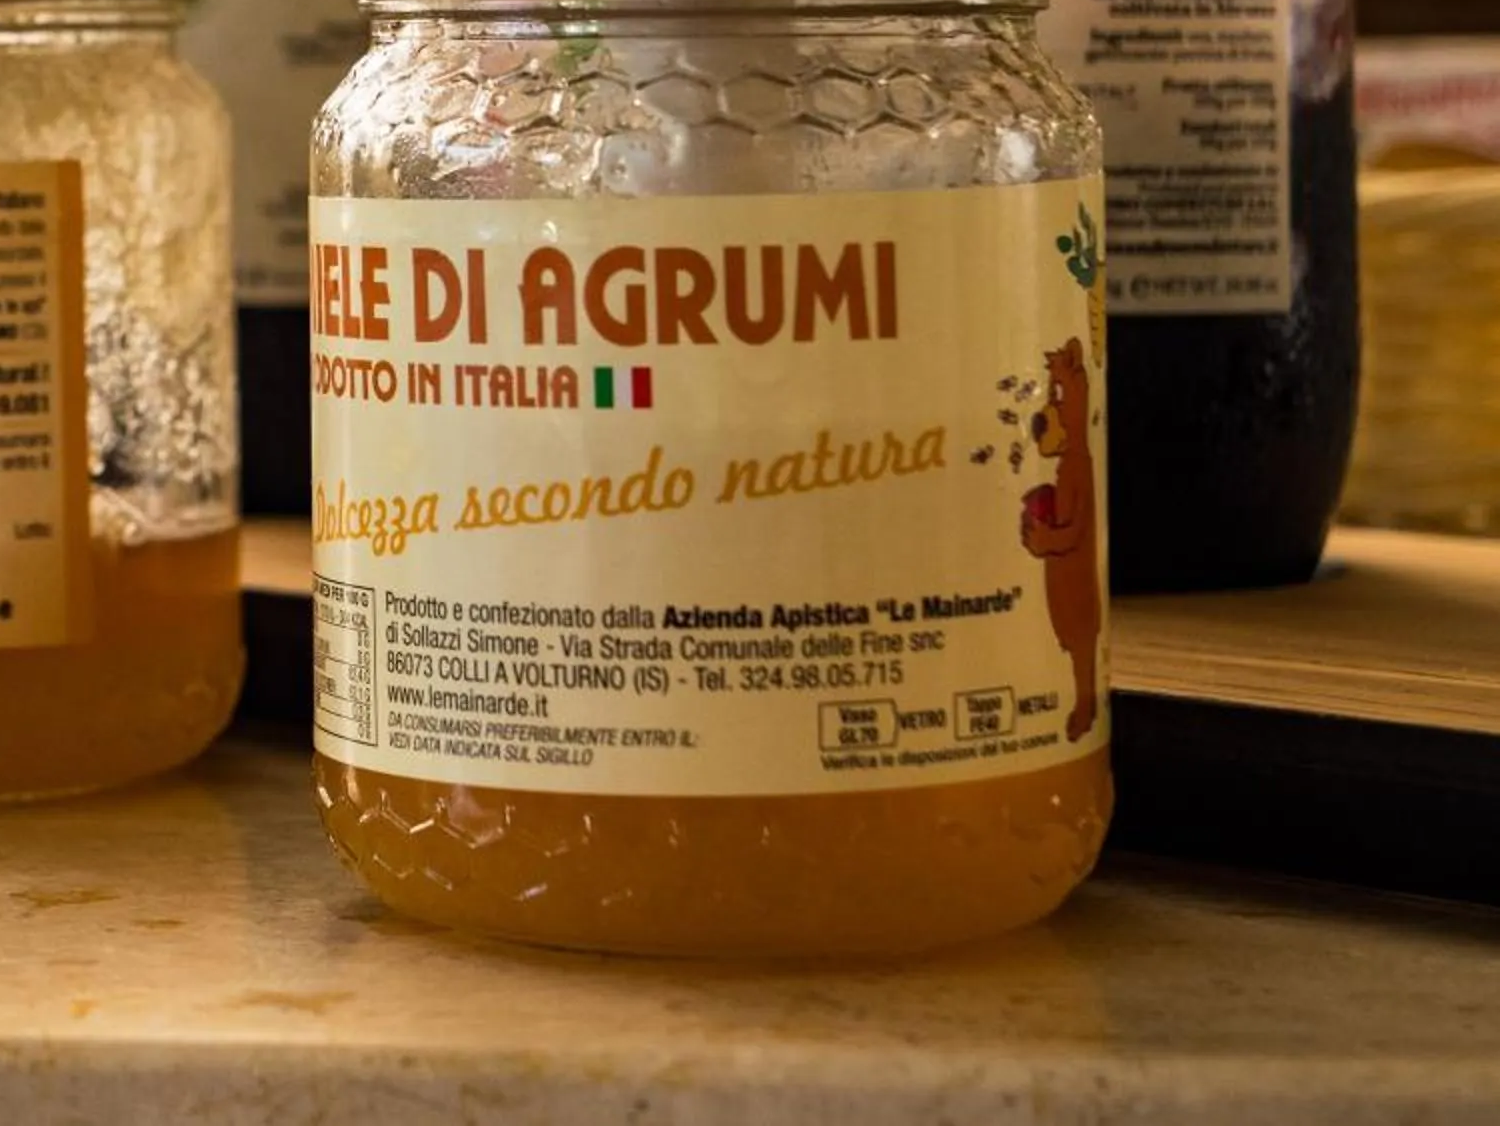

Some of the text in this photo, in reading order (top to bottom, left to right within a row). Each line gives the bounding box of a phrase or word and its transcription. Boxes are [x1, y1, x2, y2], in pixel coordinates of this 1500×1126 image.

[313, 240, 898, 347] IELE DI AGRUMI
[407, 361, 442, 405] IN
[454, 364, 579, 410] ITALIA
[315, 424, 949, 558] Dolcezza secondo natura
[385, 590, 448, 620] Prodotto
[452, 601, 464, 621] e
[468, 601, 596, 630] confezionato
[601, 603, 656, 630] dalla
[662, 603, 763, 630] Azienda
[770, 602, 871, 634] Apistica
[386, 622, 399, 645] di
[403, 624, 462, 652] Sollazzi
[467, 629, 540, 657] Simone
[560, 633, 593, 659] Via
[599, 634, 673, 662] Strada
[679, 634, 795, 662] Comunale
[801, 631, 854, 659] delle
[860, 628, 905, 655] Fine
[909, 628, 946, 652] snc
[386, 649, 434, 679] 86073
[437, 654, 490, 685] COLLI
[493, 661, 511, 685] A
[512, 661, 626, 692] VOLTURNO
[632, 664, 671, 697] (IS)
[693, 666, 734, 692] Tel.
[739, 659, 905, 693] 324.98.05.715
[386, 683, 549, 718] www.lemainarde.it
[388, 731, 594, 767] VEDI DATA INDICATA SUL SIGILLO
[405, 712, 482, 739] CONSUMARSI
[484, 721, 617, 747] PREFERIBILMENTE
[620, 727, 676, 748] ENTRO
